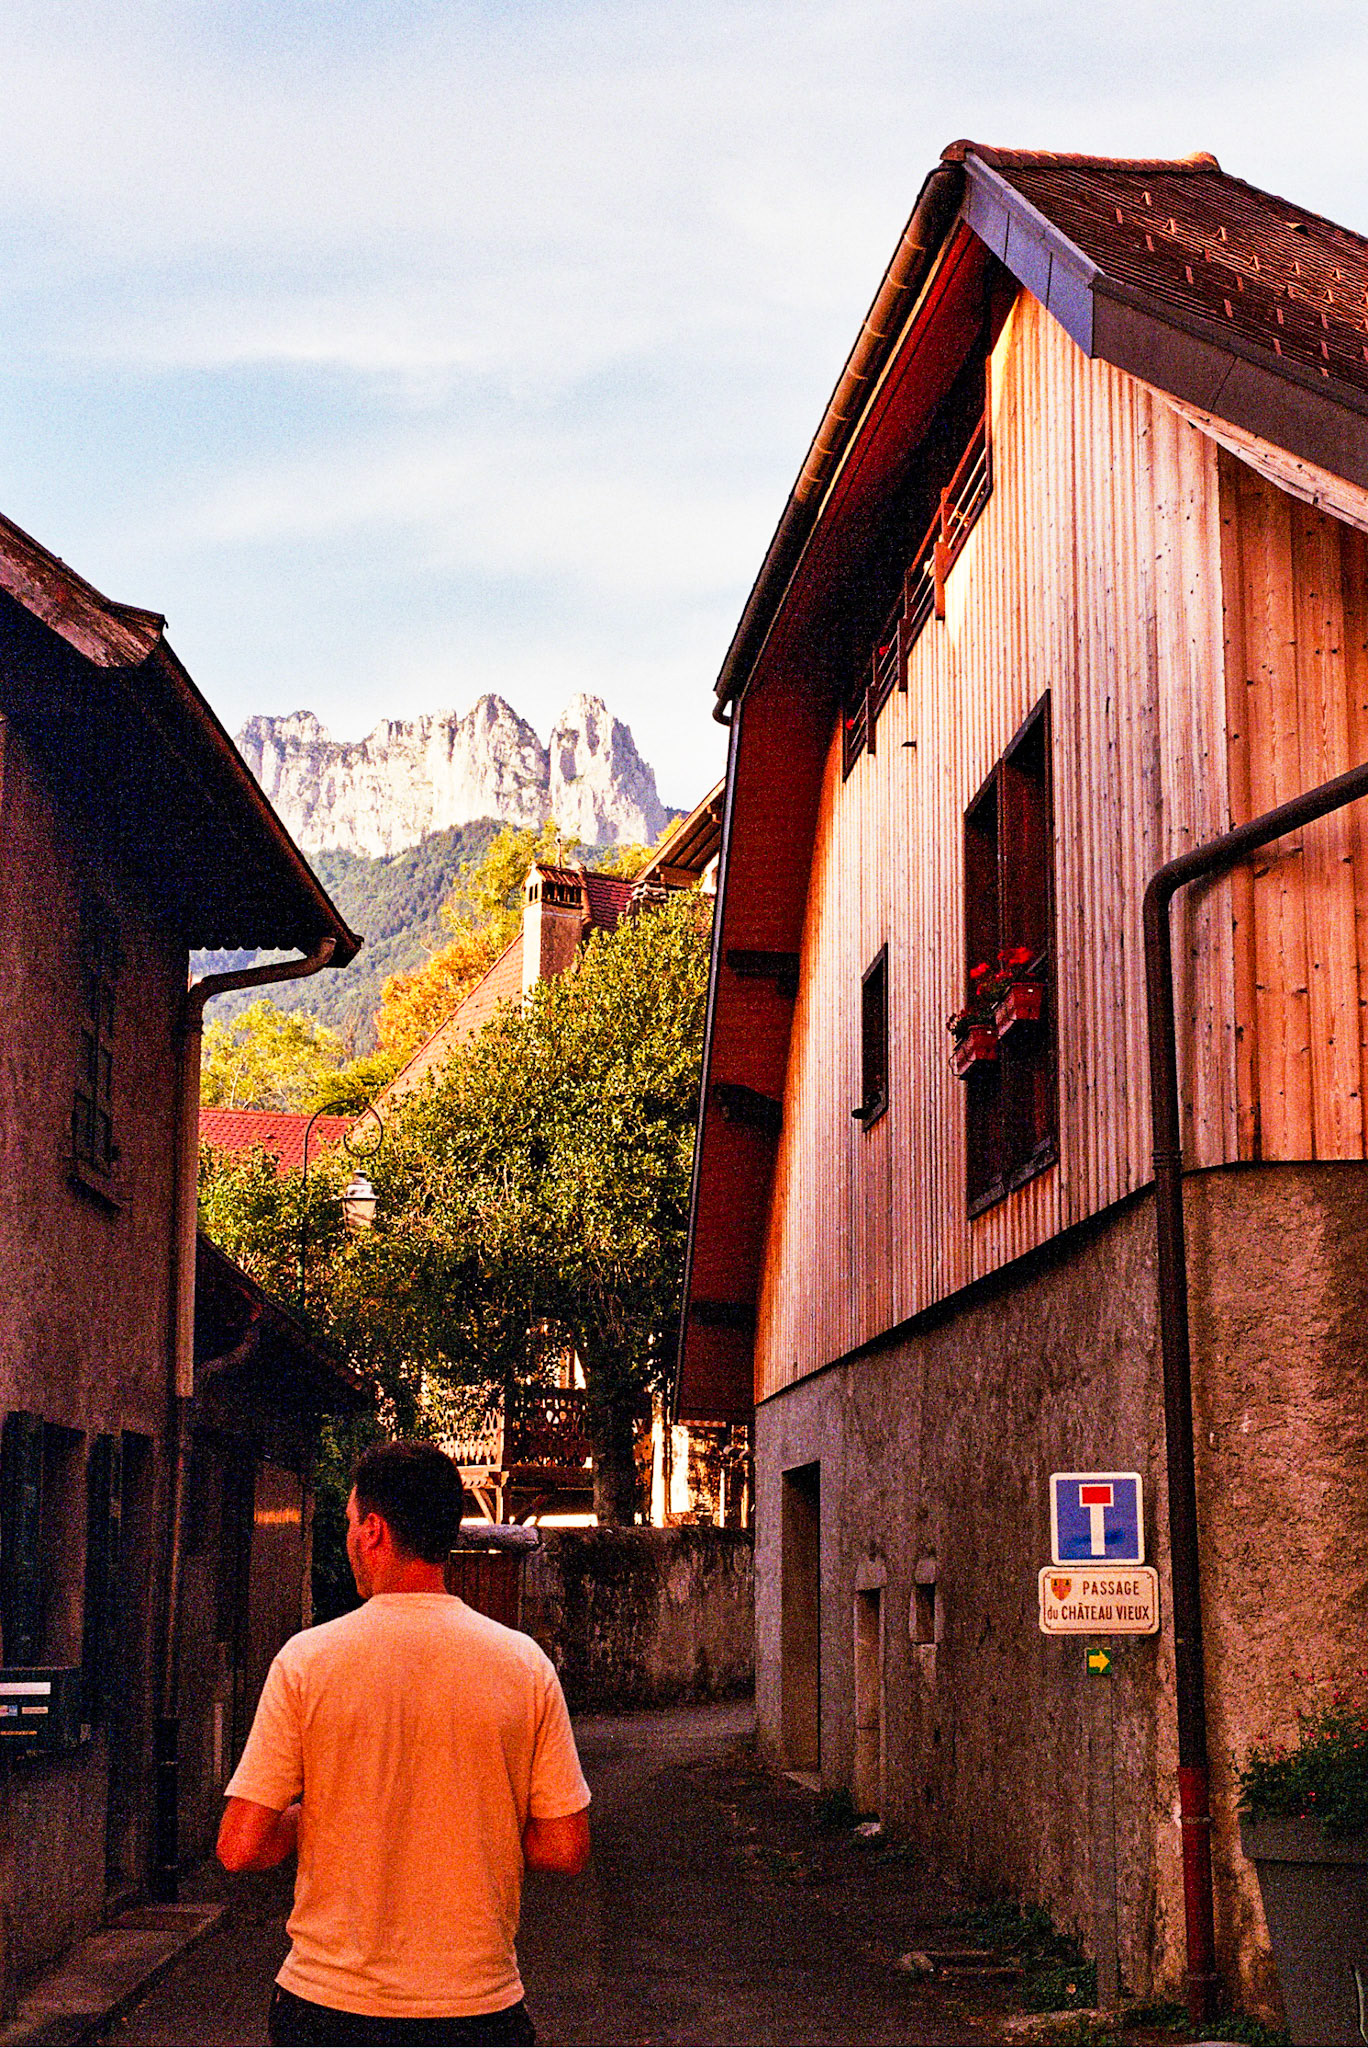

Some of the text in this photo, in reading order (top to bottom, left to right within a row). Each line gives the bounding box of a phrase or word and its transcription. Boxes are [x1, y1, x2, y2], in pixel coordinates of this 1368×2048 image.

[1082, 1580, 1140, 1596] PASSAGE
[1047, 1602, 1150, 1620] du CHÂTEAU VIEUX
